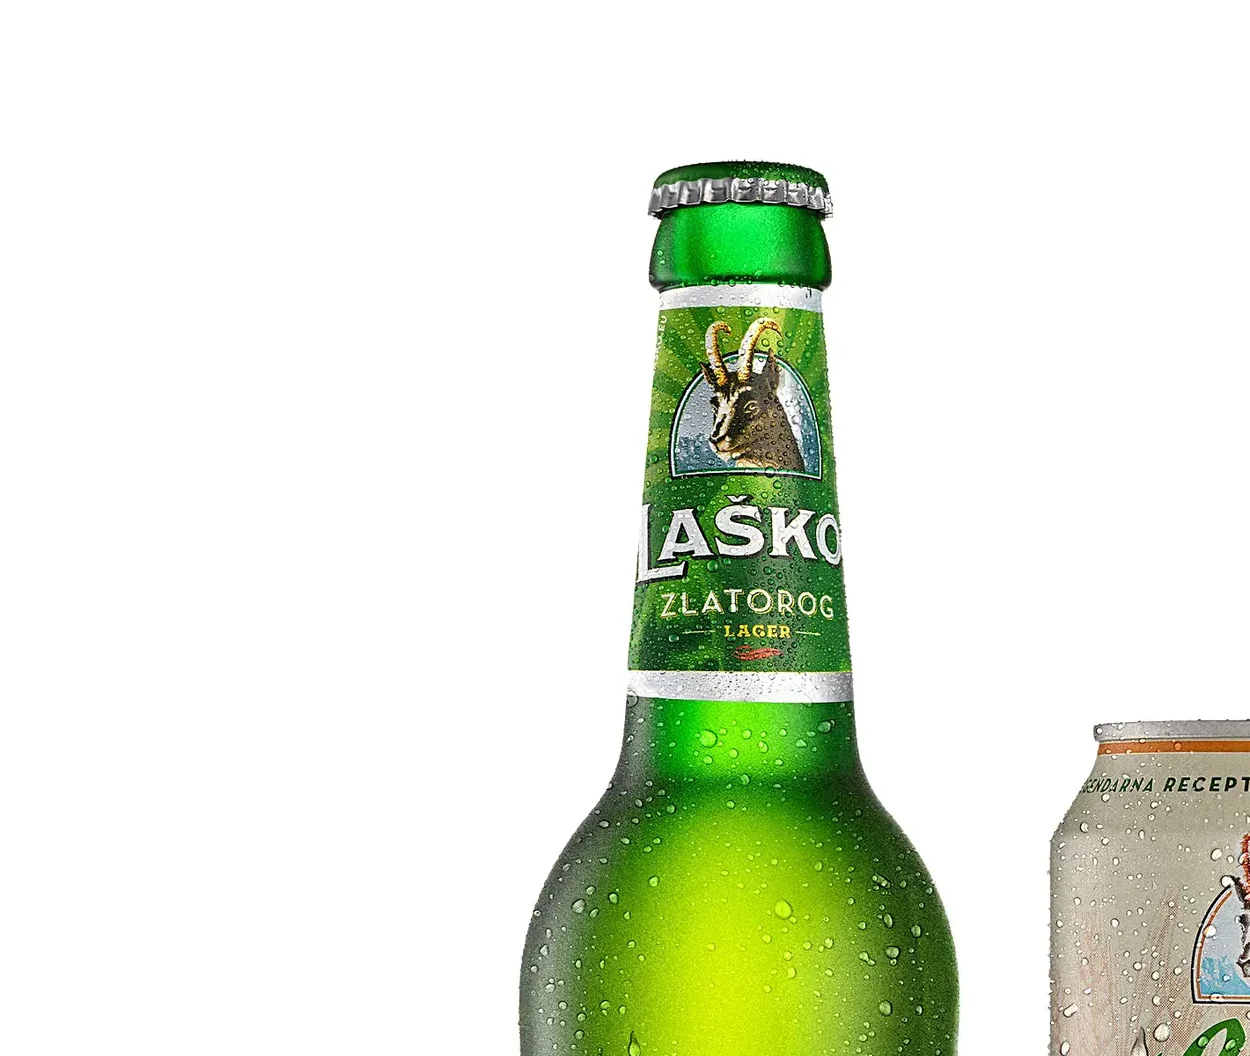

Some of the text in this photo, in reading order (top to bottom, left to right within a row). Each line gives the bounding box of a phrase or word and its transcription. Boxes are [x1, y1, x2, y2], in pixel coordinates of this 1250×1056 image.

[636, 494, 842, 585] LAŠKO
[660, 588, 834, 619] ZLATOROG
[724, 624, 791, 639] LAGER
[1079, 778, 1153, 794] GENDARNA
